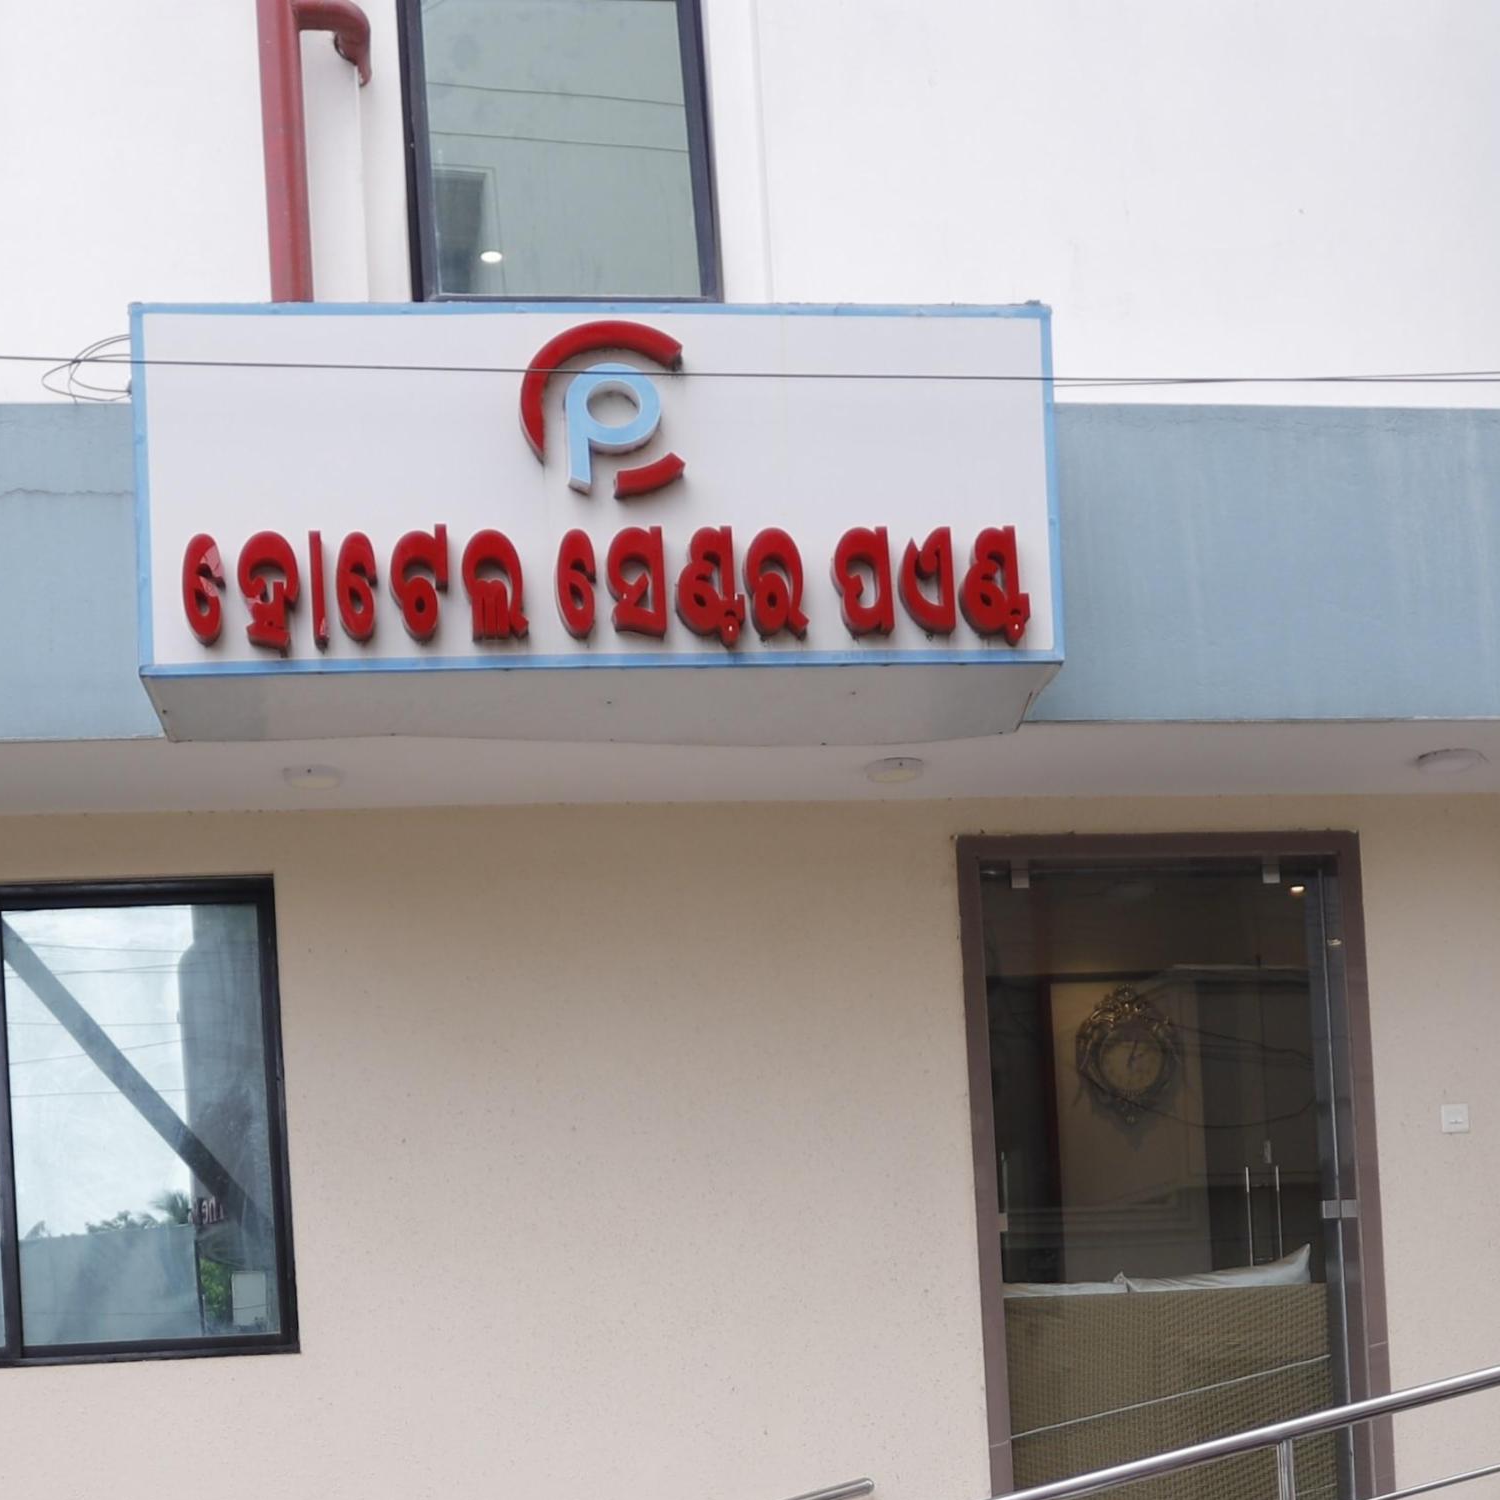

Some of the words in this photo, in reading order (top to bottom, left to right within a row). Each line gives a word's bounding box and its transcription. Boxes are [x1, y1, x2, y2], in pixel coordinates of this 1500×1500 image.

[182, 524, 529, 657] ହୋଟେଲ
[554, 525, 810, 650] ସେଣ୍ଟର
[831, 525, 1030, 646] ପଏଣ୍ଟ
